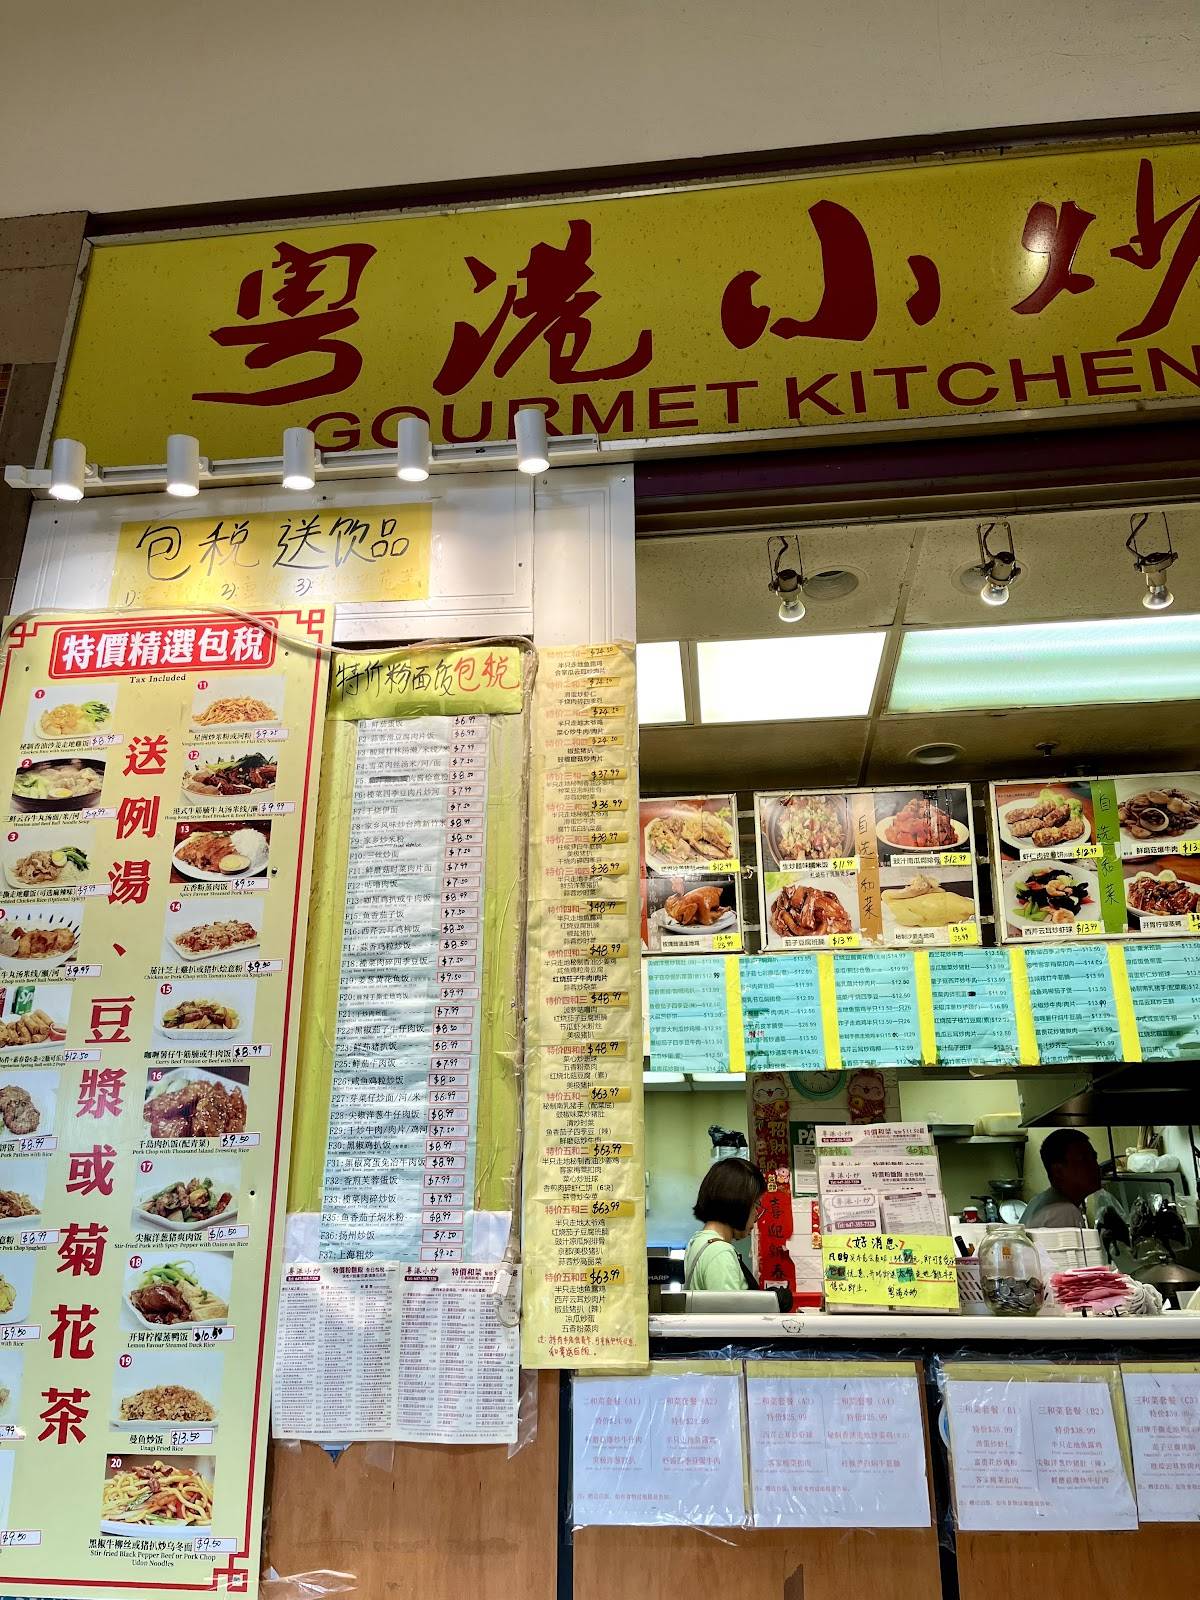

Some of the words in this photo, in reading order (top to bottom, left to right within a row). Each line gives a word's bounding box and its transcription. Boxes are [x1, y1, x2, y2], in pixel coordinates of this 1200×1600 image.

[306, 380, 759, 453] GOURMET
[785, 345, 1200, 420] KITCHEN
[130, 676, 145, 684] Tax
[148, 674, 186, 683] Included
[432, 1109, 454, 1120] $8.99
[429, 1141, 452, 1151] $8.99
[593, 1144, 622, 1156] $63.99
[432, 1157, 455, 1168] $8.99
[592, 1202, 619, 1214] $63.99
[430, 1212, 450, 1222] $8.99
[590, 1269, 620, 1284] $63.99
[196, 1538, 221, 1551] $9.50
[138, 1552, 159, 1560] Pepper
